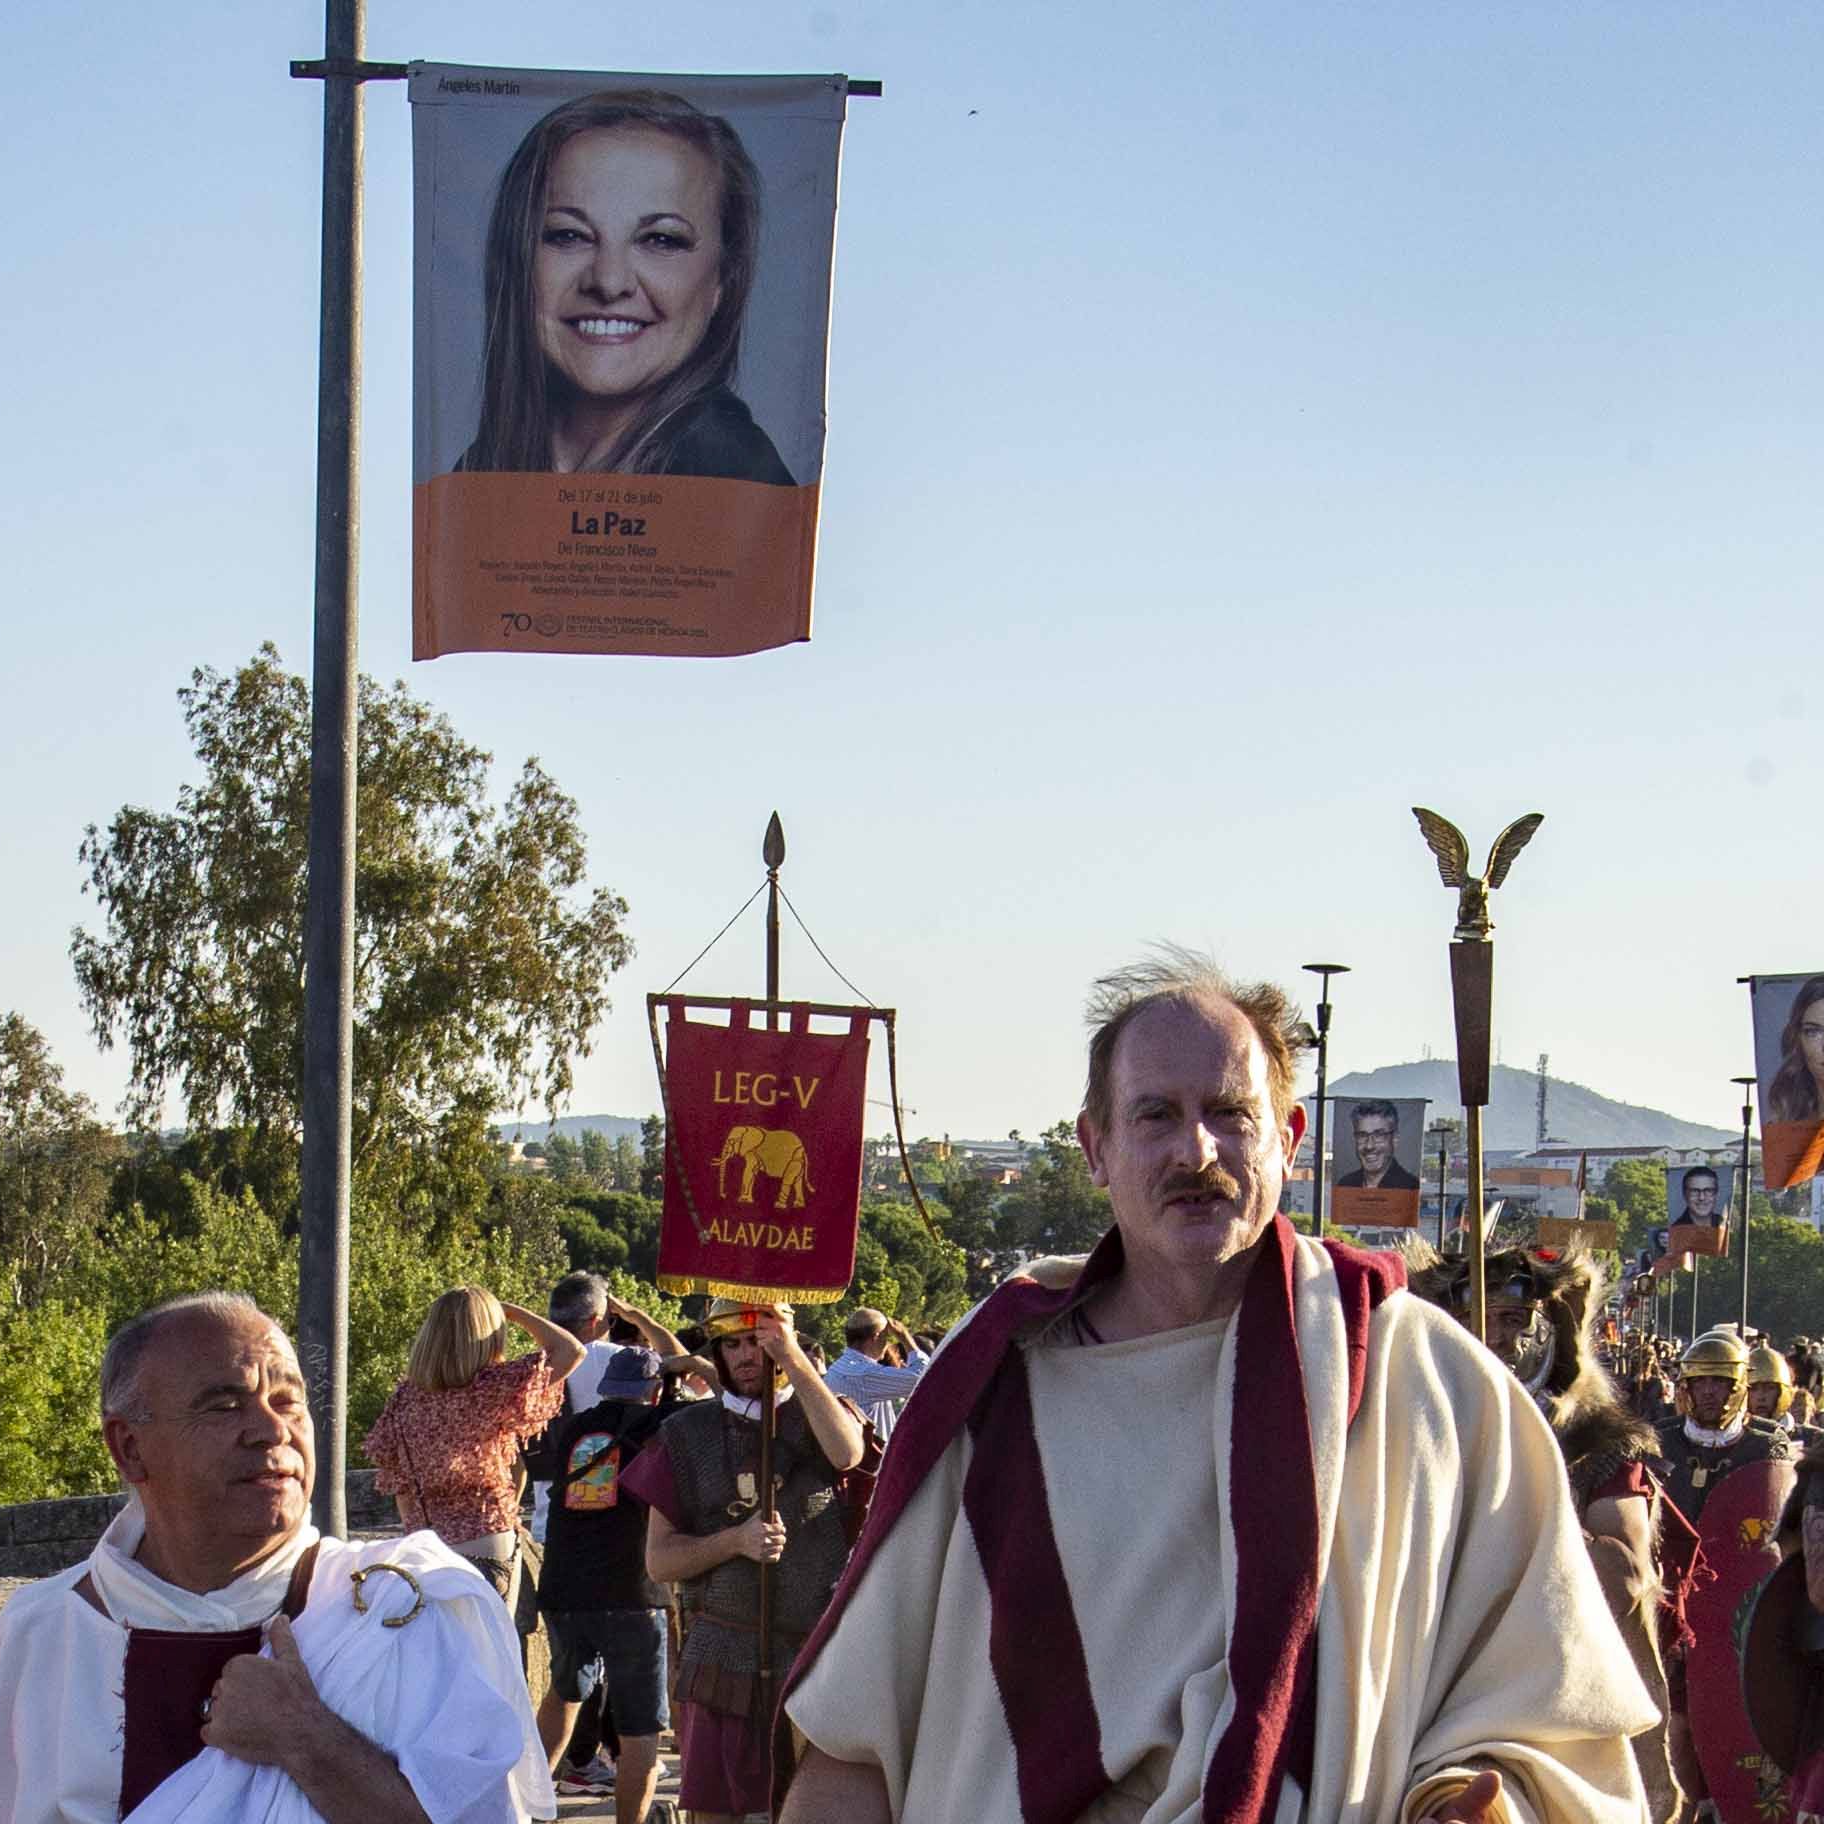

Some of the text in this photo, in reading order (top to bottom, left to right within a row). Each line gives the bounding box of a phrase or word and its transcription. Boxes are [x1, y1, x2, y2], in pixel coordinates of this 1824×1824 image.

[571, 511, 647, 536] La Paz
[558, 542, 572, 555] De
[575, 542, 625, 557] Francisco
[501, 613, 532, 637] 70
[713, 1070, 819, 1109] LEG-V
[708, 1217, 815, 1250] ALAVDAE
